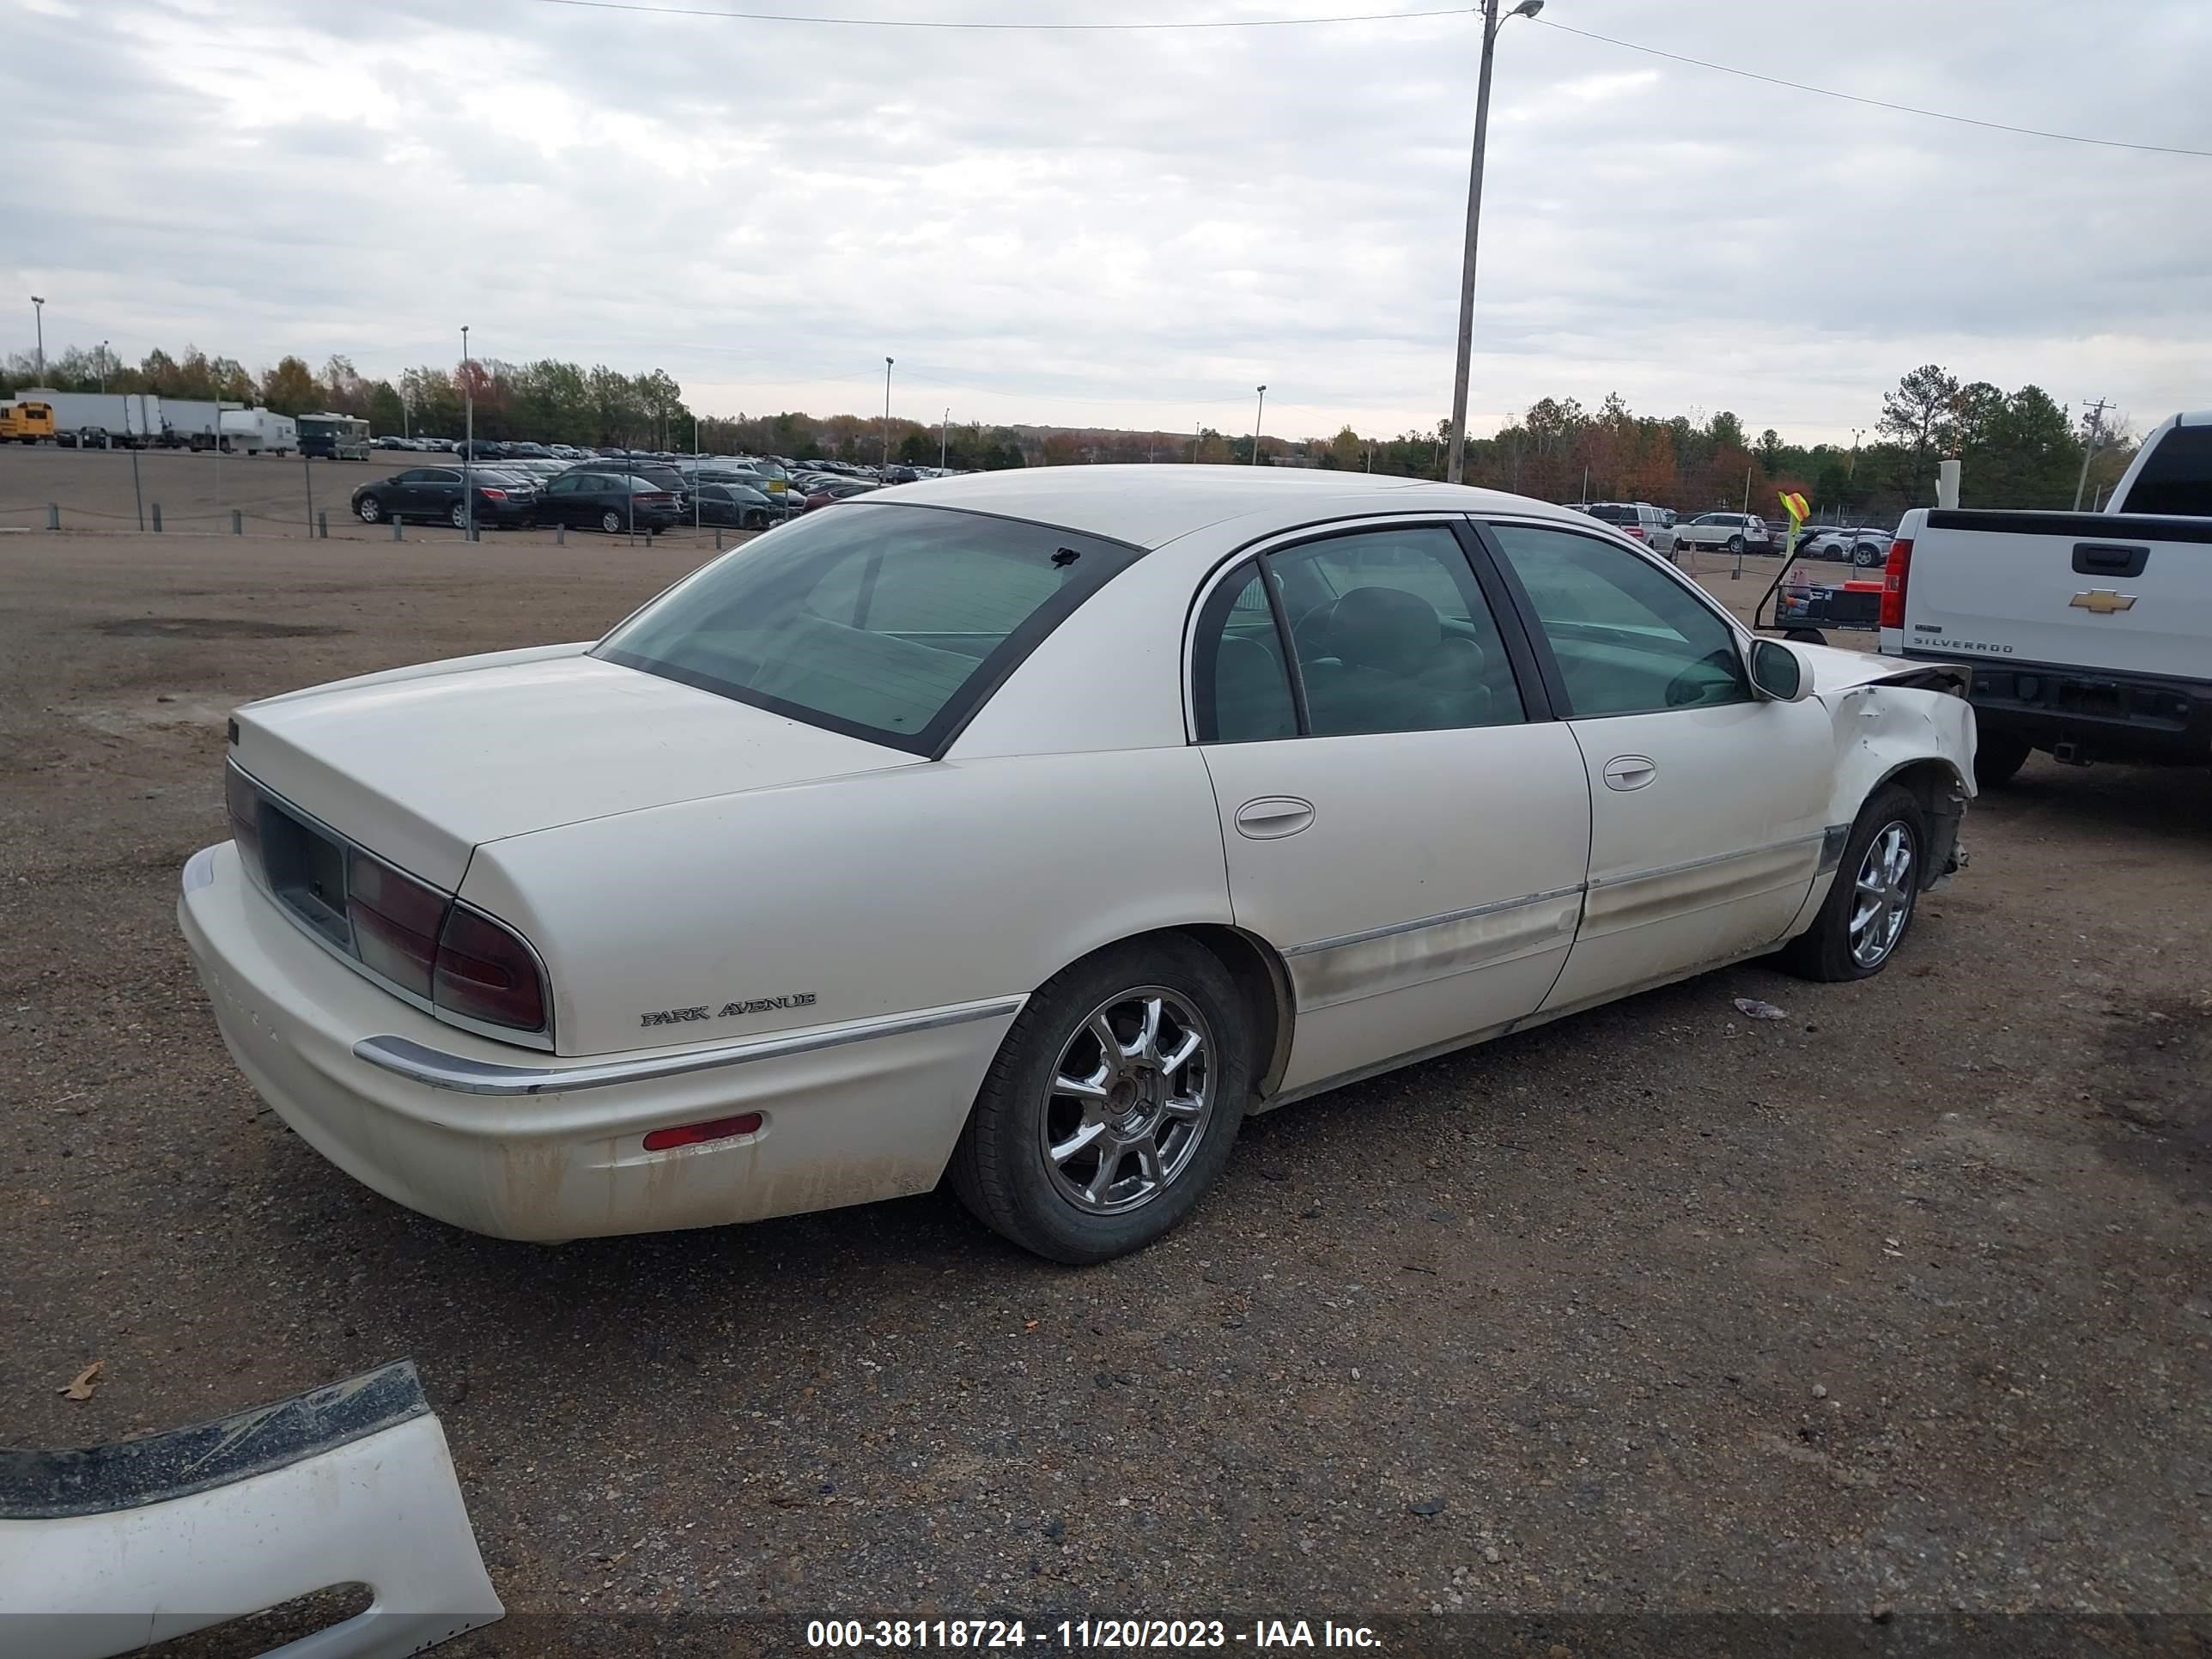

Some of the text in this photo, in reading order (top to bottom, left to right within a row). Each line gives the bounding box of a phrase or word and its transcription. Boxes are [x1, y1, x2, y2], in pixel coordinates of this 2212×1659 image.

[1913, 636, 2014, 653] SILVERADO
[641, 992, 817, 1027] PARK AVENUE
